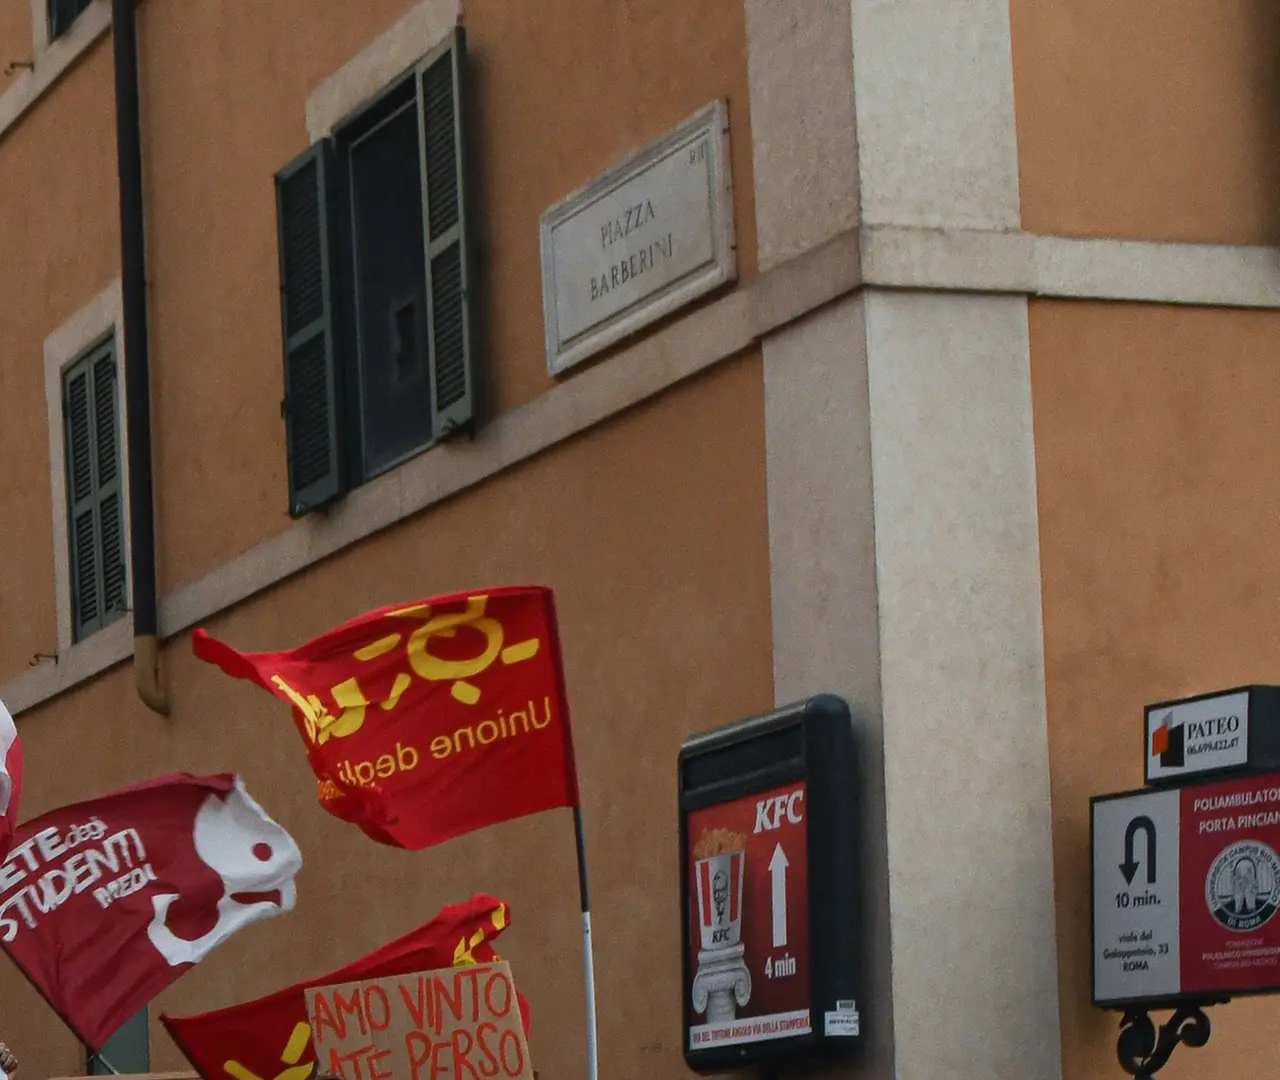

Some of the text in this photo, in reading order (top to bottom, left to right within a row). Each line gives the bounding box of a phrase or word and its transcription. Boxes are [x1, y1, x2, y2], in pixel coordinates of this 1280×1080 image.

[600, 200, 656, 249] PIAZZA
[590, 232, 674, 302] BARBERINI
[1187, 715, 1240, 741] PATEO
[752, 789, 804, 835] KFC
[1199, 817, 1236, 834] PORTA
[92, 862, 159, 909] MEDI
[1115, 889, 1162, 909] 10 min.
[712, 927, 731, 944] KFC
[764, 952, 796, 979] 4 min
[312, 967, 512, 1044] AMO VINTO
